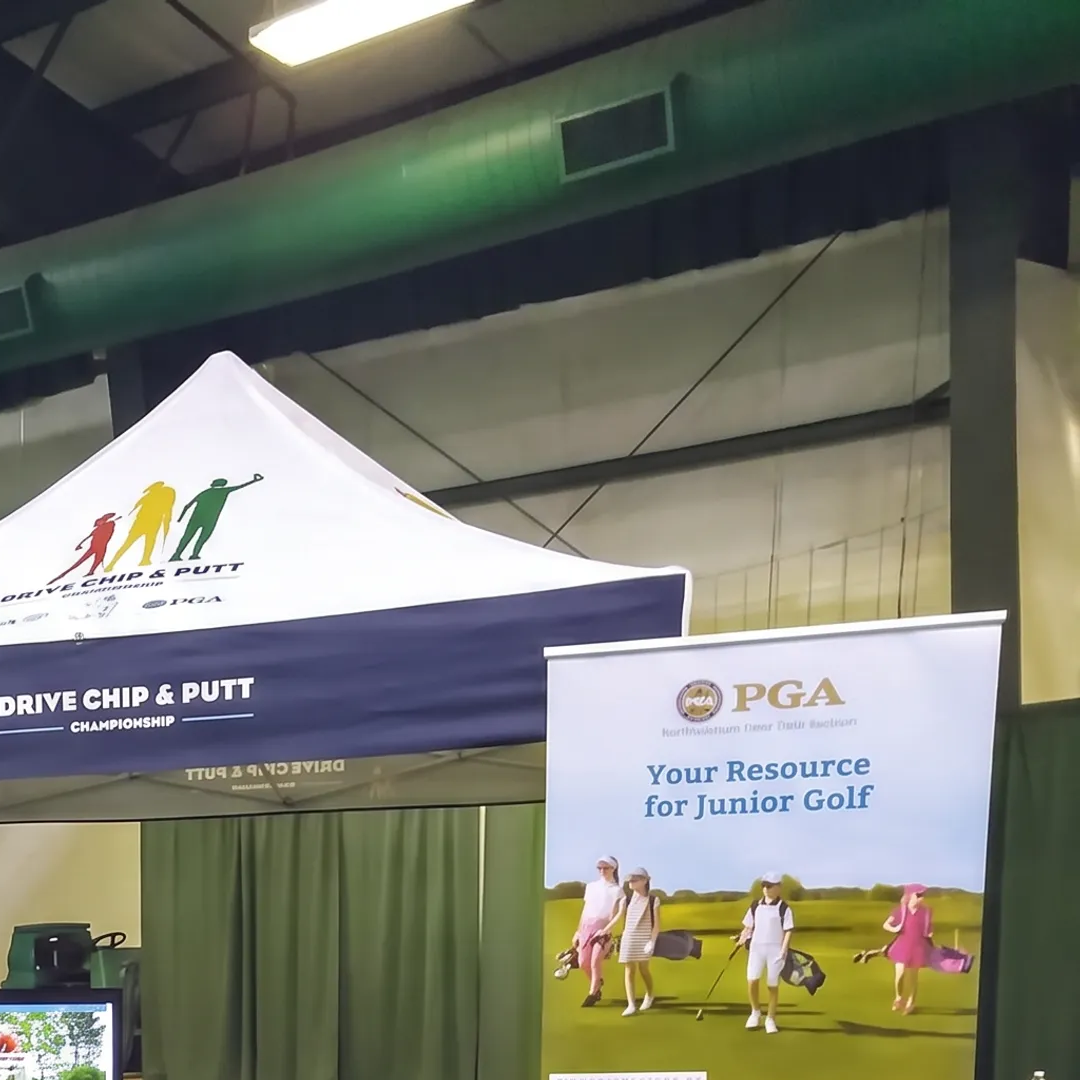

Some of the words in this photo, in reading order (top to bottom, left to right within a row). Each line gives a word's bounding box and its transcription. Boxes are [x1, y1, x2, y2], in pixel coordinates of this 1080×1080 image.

[0, 583, 76, 602] DRIVE
[81, 571, 143, 588] CHIP
[149, 568, 166, 579] &
[174, 562, 246, 577] PUTT
[82, 683, 150, 711] CHIP
[155, 683, 176, 706] &
[182, 677, 255, 704] PUTT
[731, 677, 846, 713] PGA
[70, 714, 176, 734] CHAMPIONSHIP
[647, 763, 718, 786] Your
[726, 757, 871, 783] Resource
[644, 794, 688, 818] for
[694, 790, 794, 820] Junior
[803, 784, 874, 812] Golf
